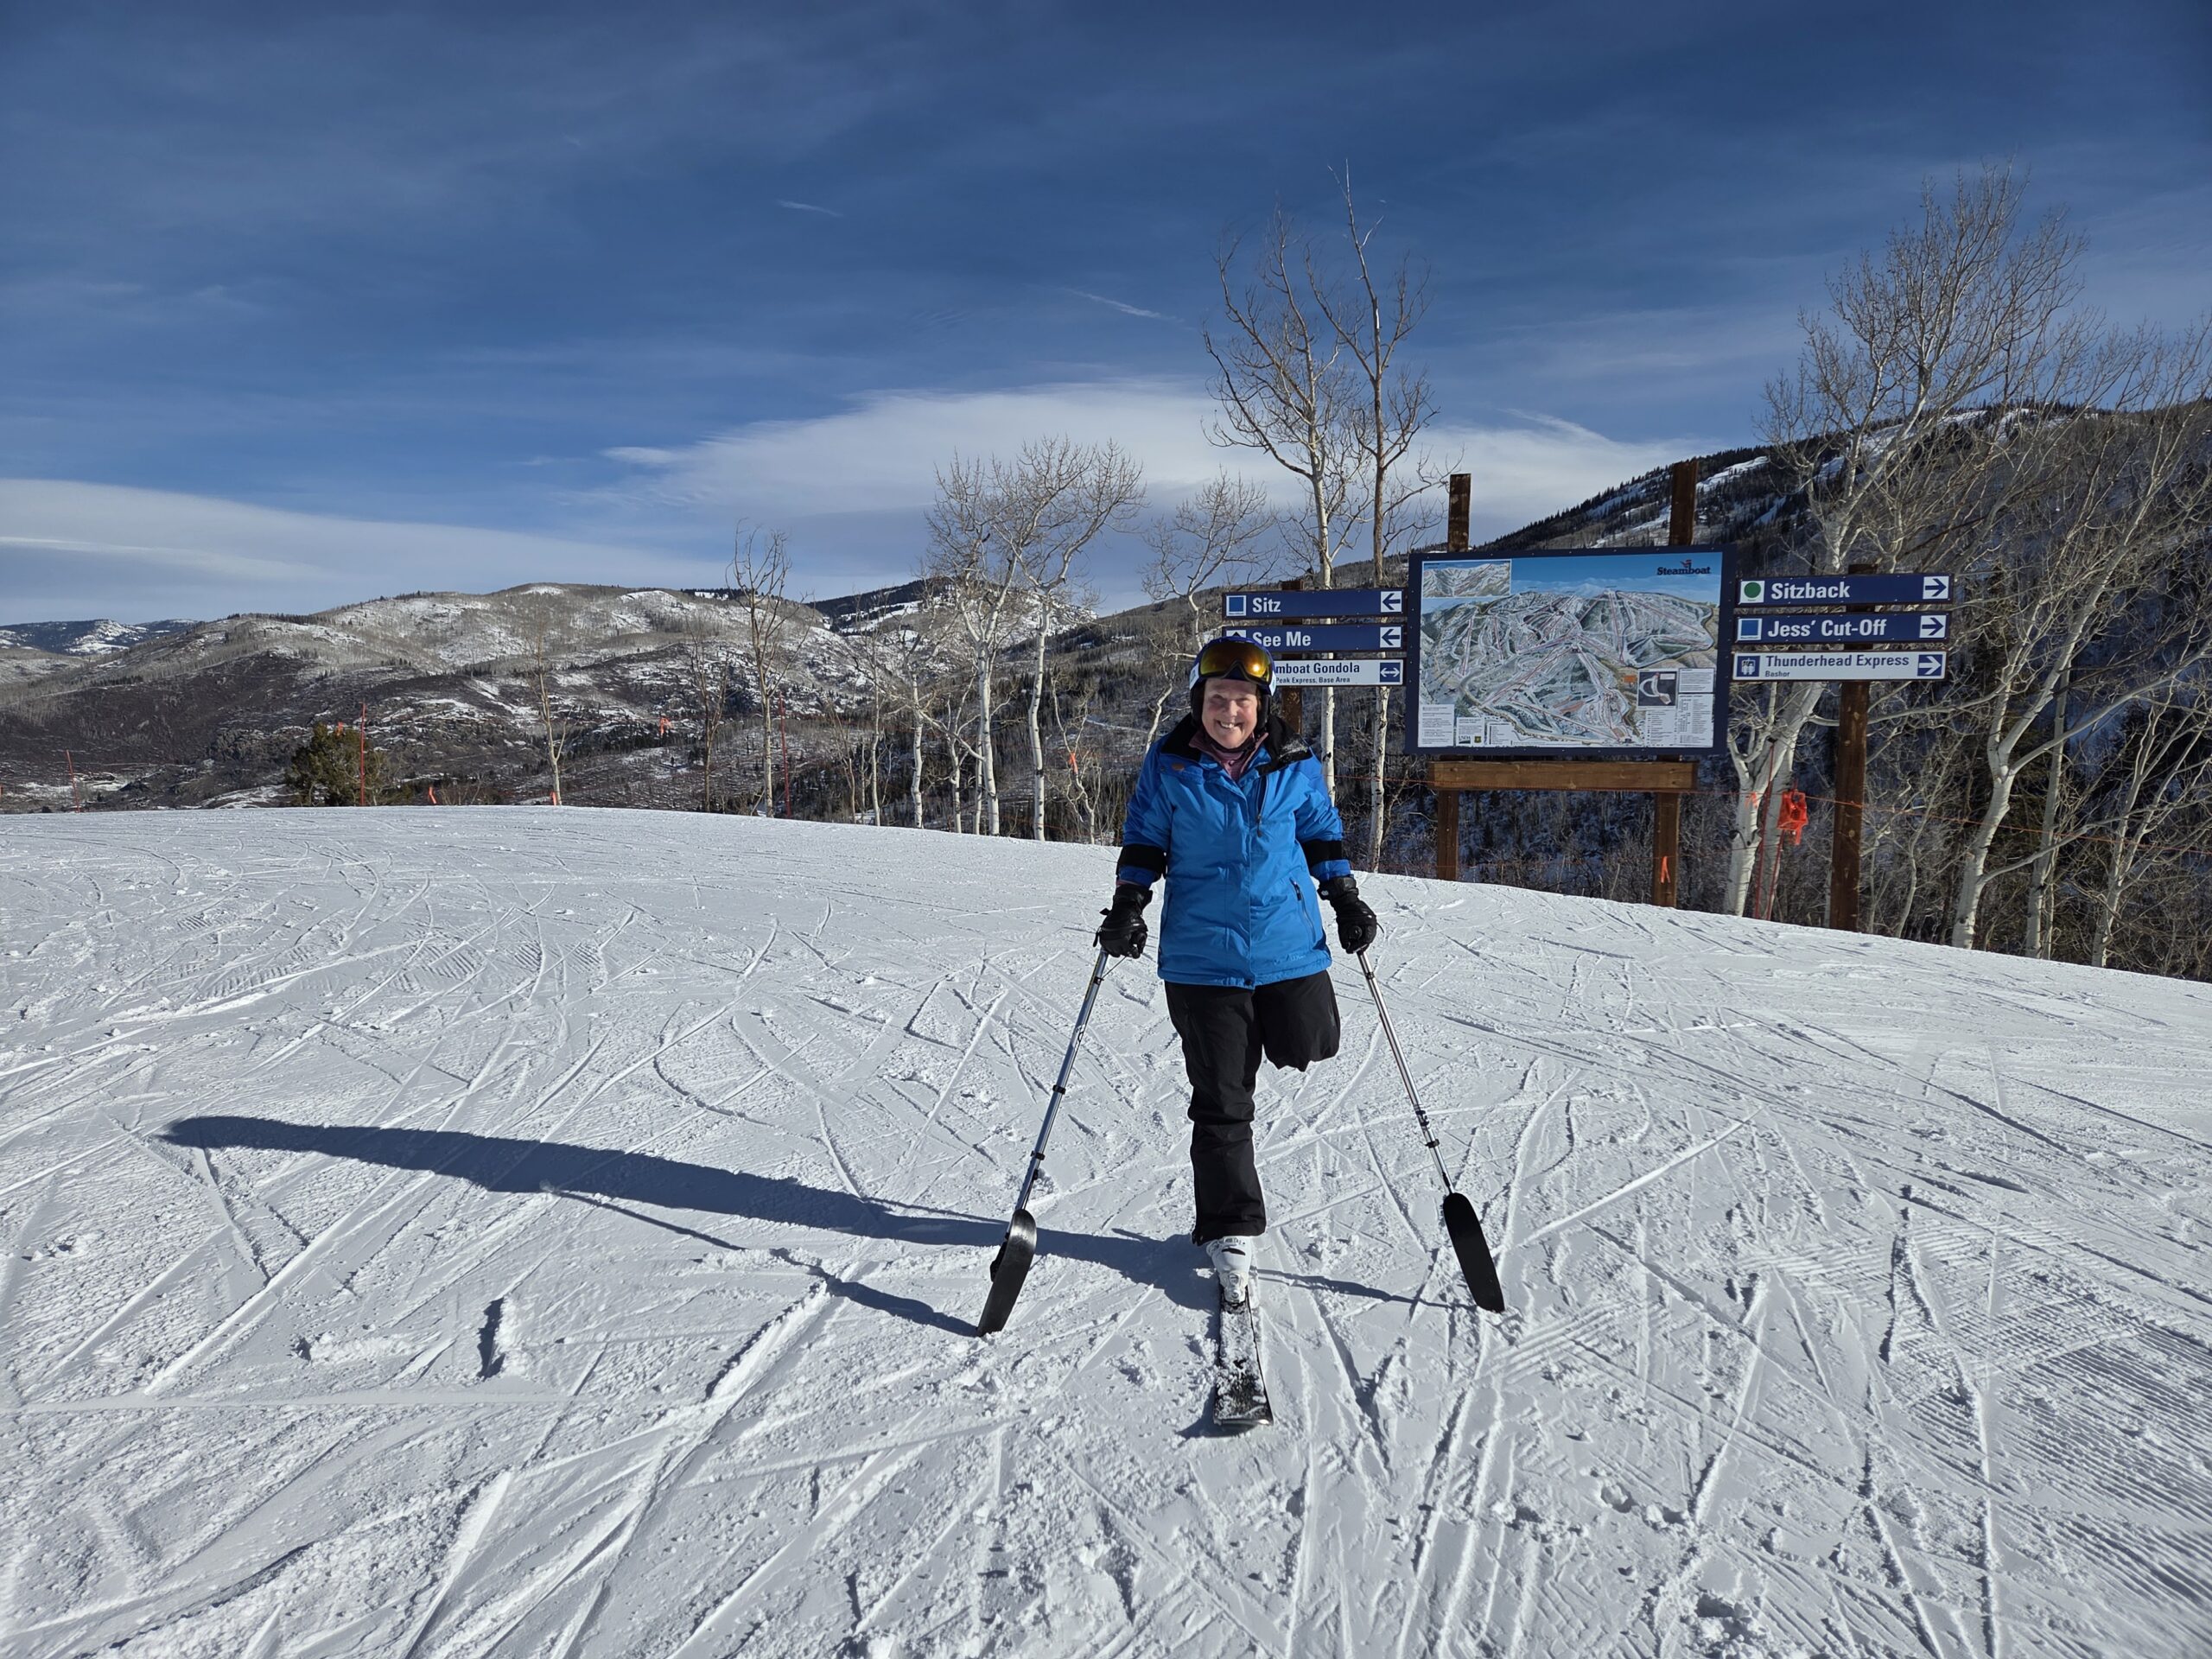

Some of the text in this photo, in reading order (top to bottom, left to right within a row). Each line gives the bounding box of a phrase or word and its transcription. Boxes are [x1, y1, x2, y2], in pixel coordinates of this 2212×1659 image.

[1657, 564, 1712, 575] Steamboat
[1771, 582, 1850, 600] Sitzback
[1252, 597, 1281, 613] Sitz
[1821, 619, 1887, 637] Cut-Off
[1252, 631, 1312, 647] See Me
[1275, 662, 1360, 674] mboat Gondola
[1765, 654, 1910, 669] Thunderhead Express
